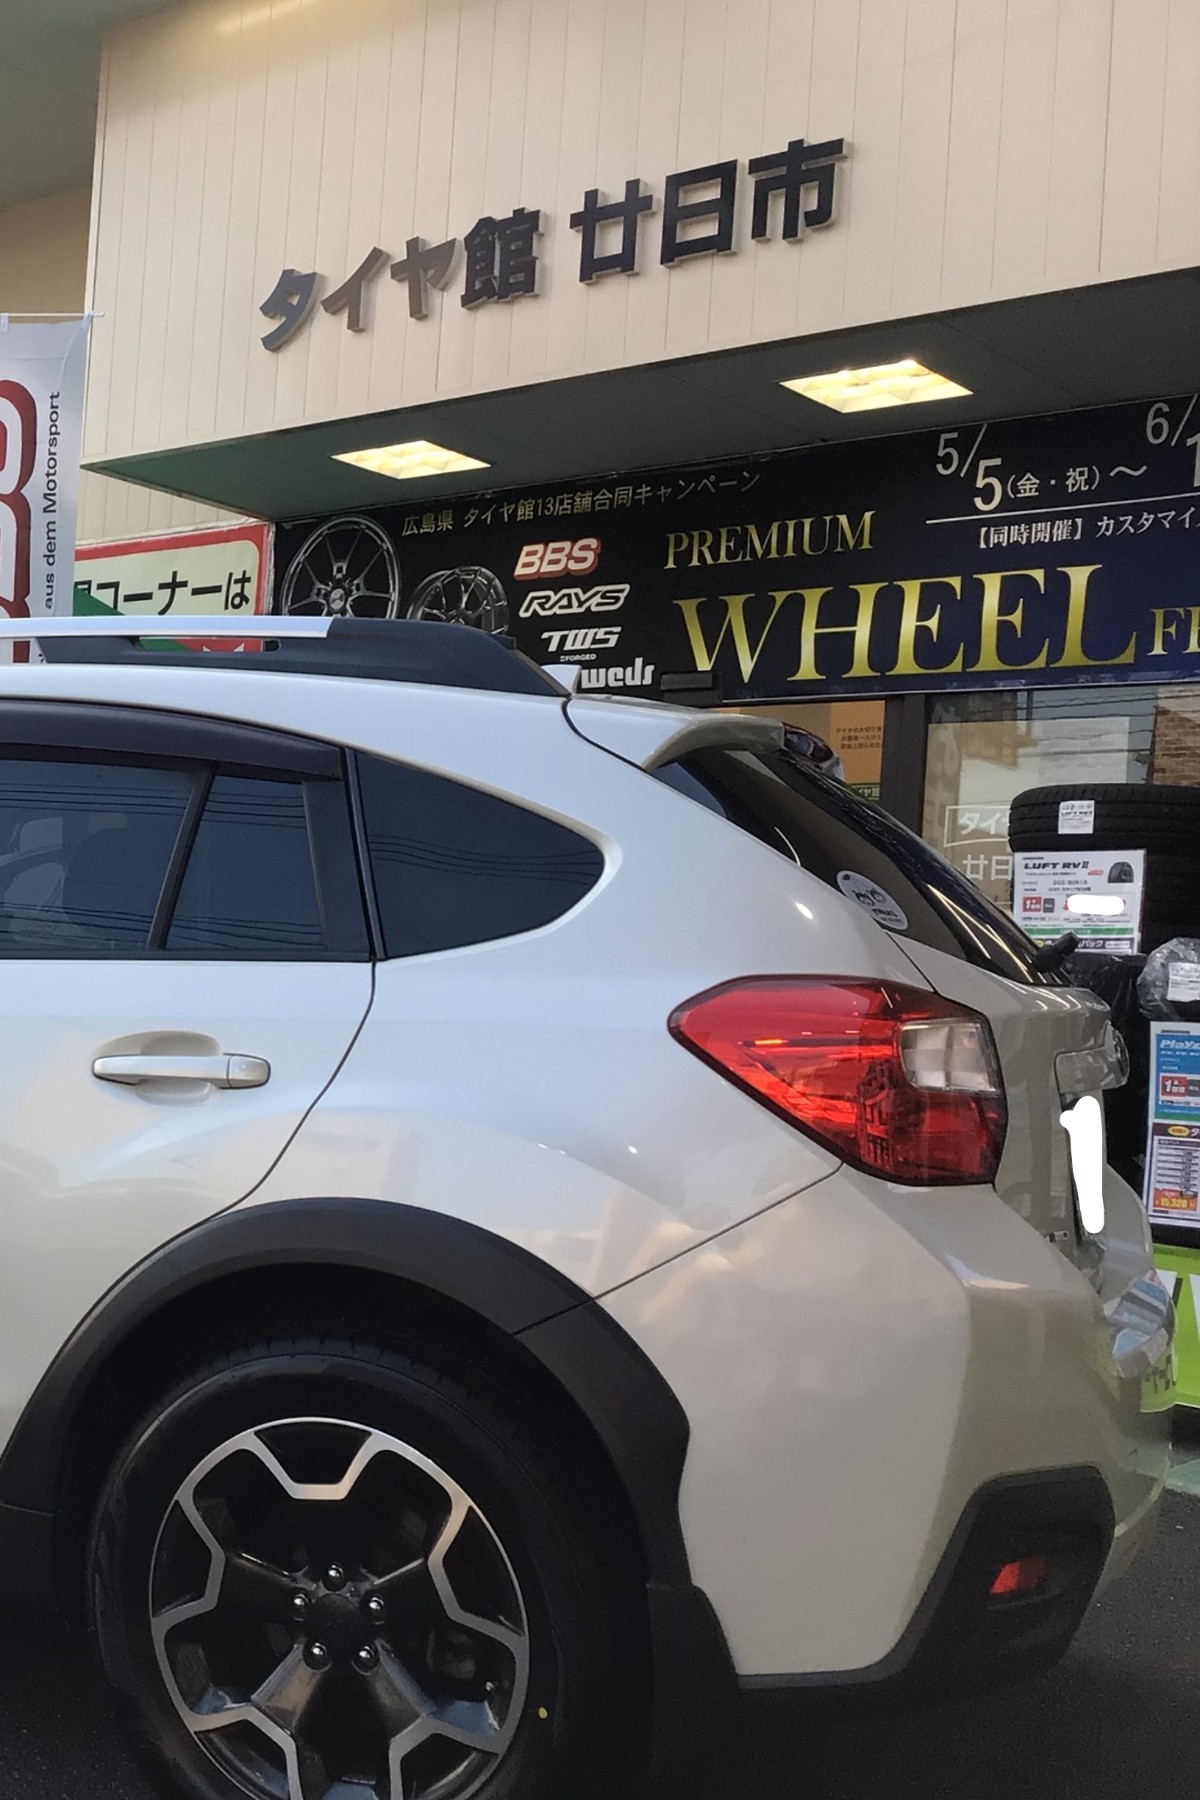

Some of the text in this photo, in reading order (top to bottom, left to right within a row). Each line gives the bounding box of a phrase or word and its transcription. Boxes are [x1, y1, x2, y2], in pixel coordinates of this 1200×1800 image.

[259, 138, 847, 352] タイヤ館 廿日市
[42, 391, 61, 610] aus dem Motorsport
[1096, 506, 1200, 538] カスタマイ
[401, 509, 454, 536] 広島県
[664, 510, 877, 569] PREMIUM
[514, 538, 601, 581] BBS
[74, 570, 252, 615] コーナーは
[519, 584, 631, 618] RAYS
[541, 626, 622, 652] TWS
[673, 564, 1137, 683] WHEEL
[581, 657, 655, 689] weds
